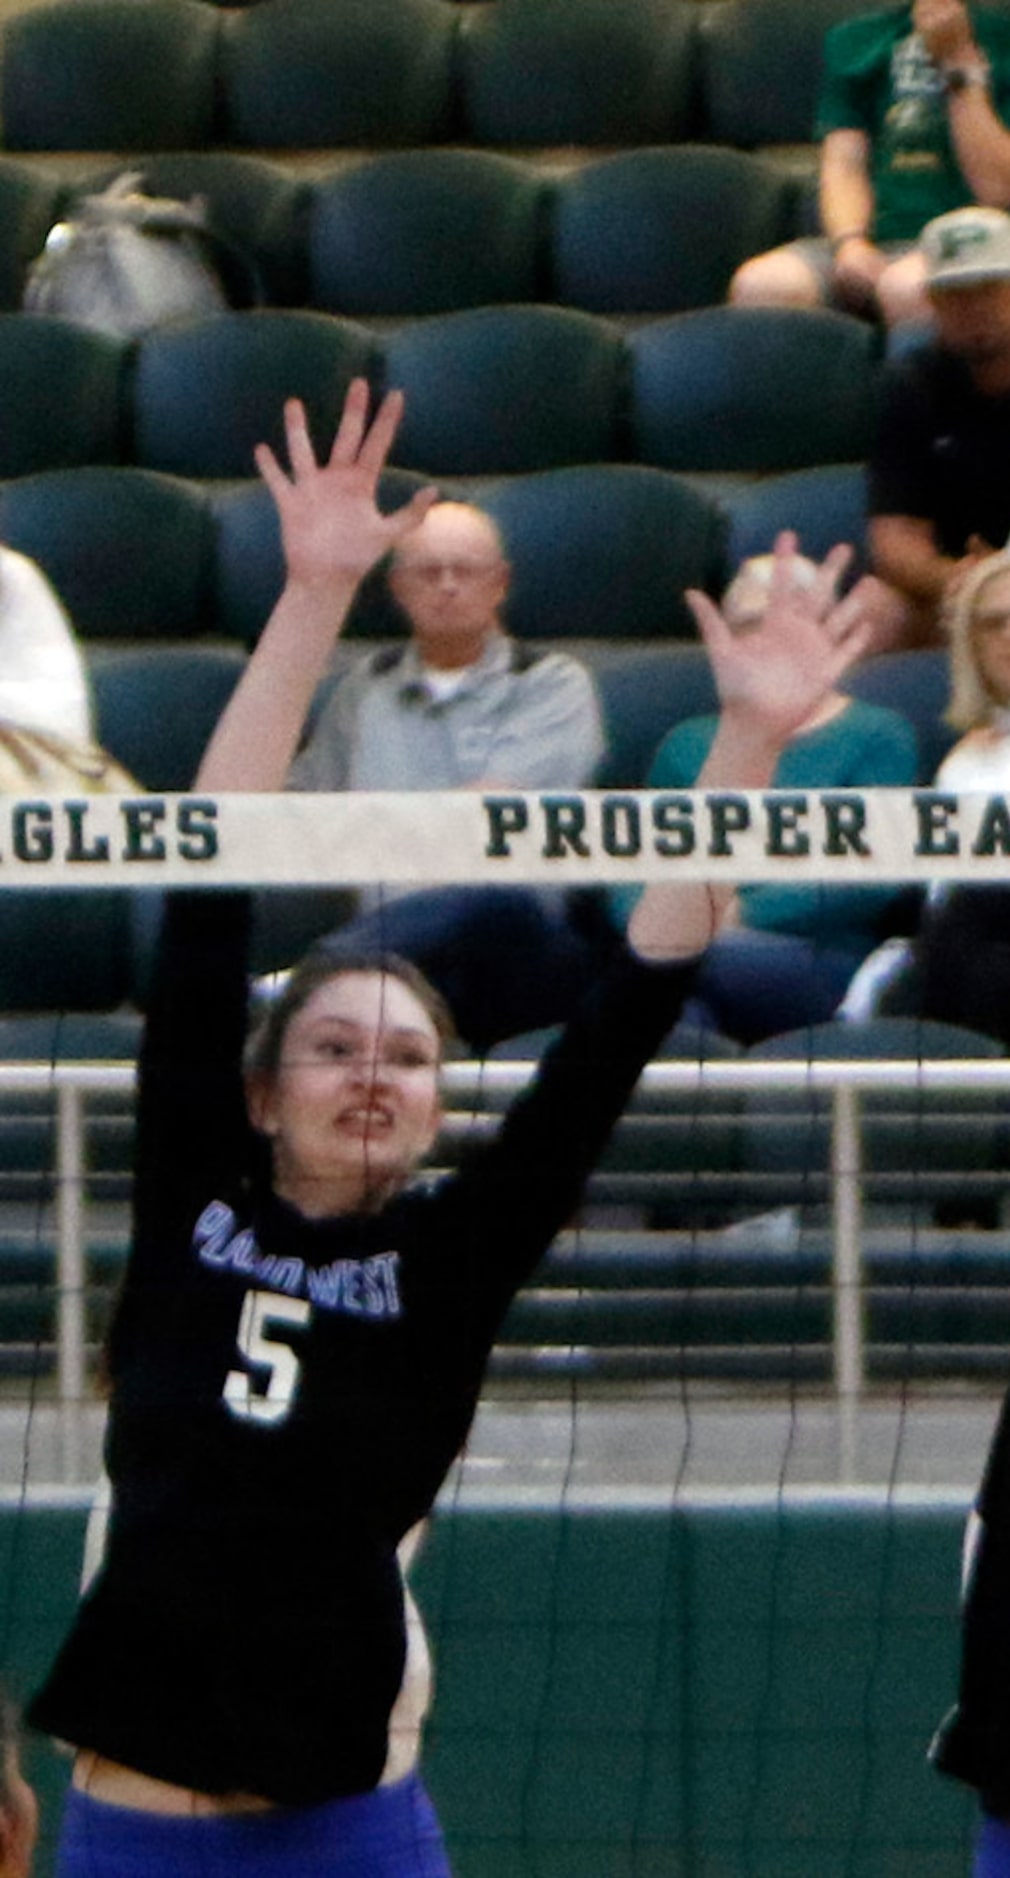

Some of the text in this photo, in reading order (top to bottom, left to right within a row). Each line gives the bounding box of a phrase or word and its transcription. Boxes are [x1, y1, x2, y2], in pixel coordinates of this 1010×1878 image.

[0, 799, 219, 862] GLES
[483, 793, 871, 857] PROSPER
[307, 1251, 401, 1315] WEST
[222, 1288, 311, 1421] 5
